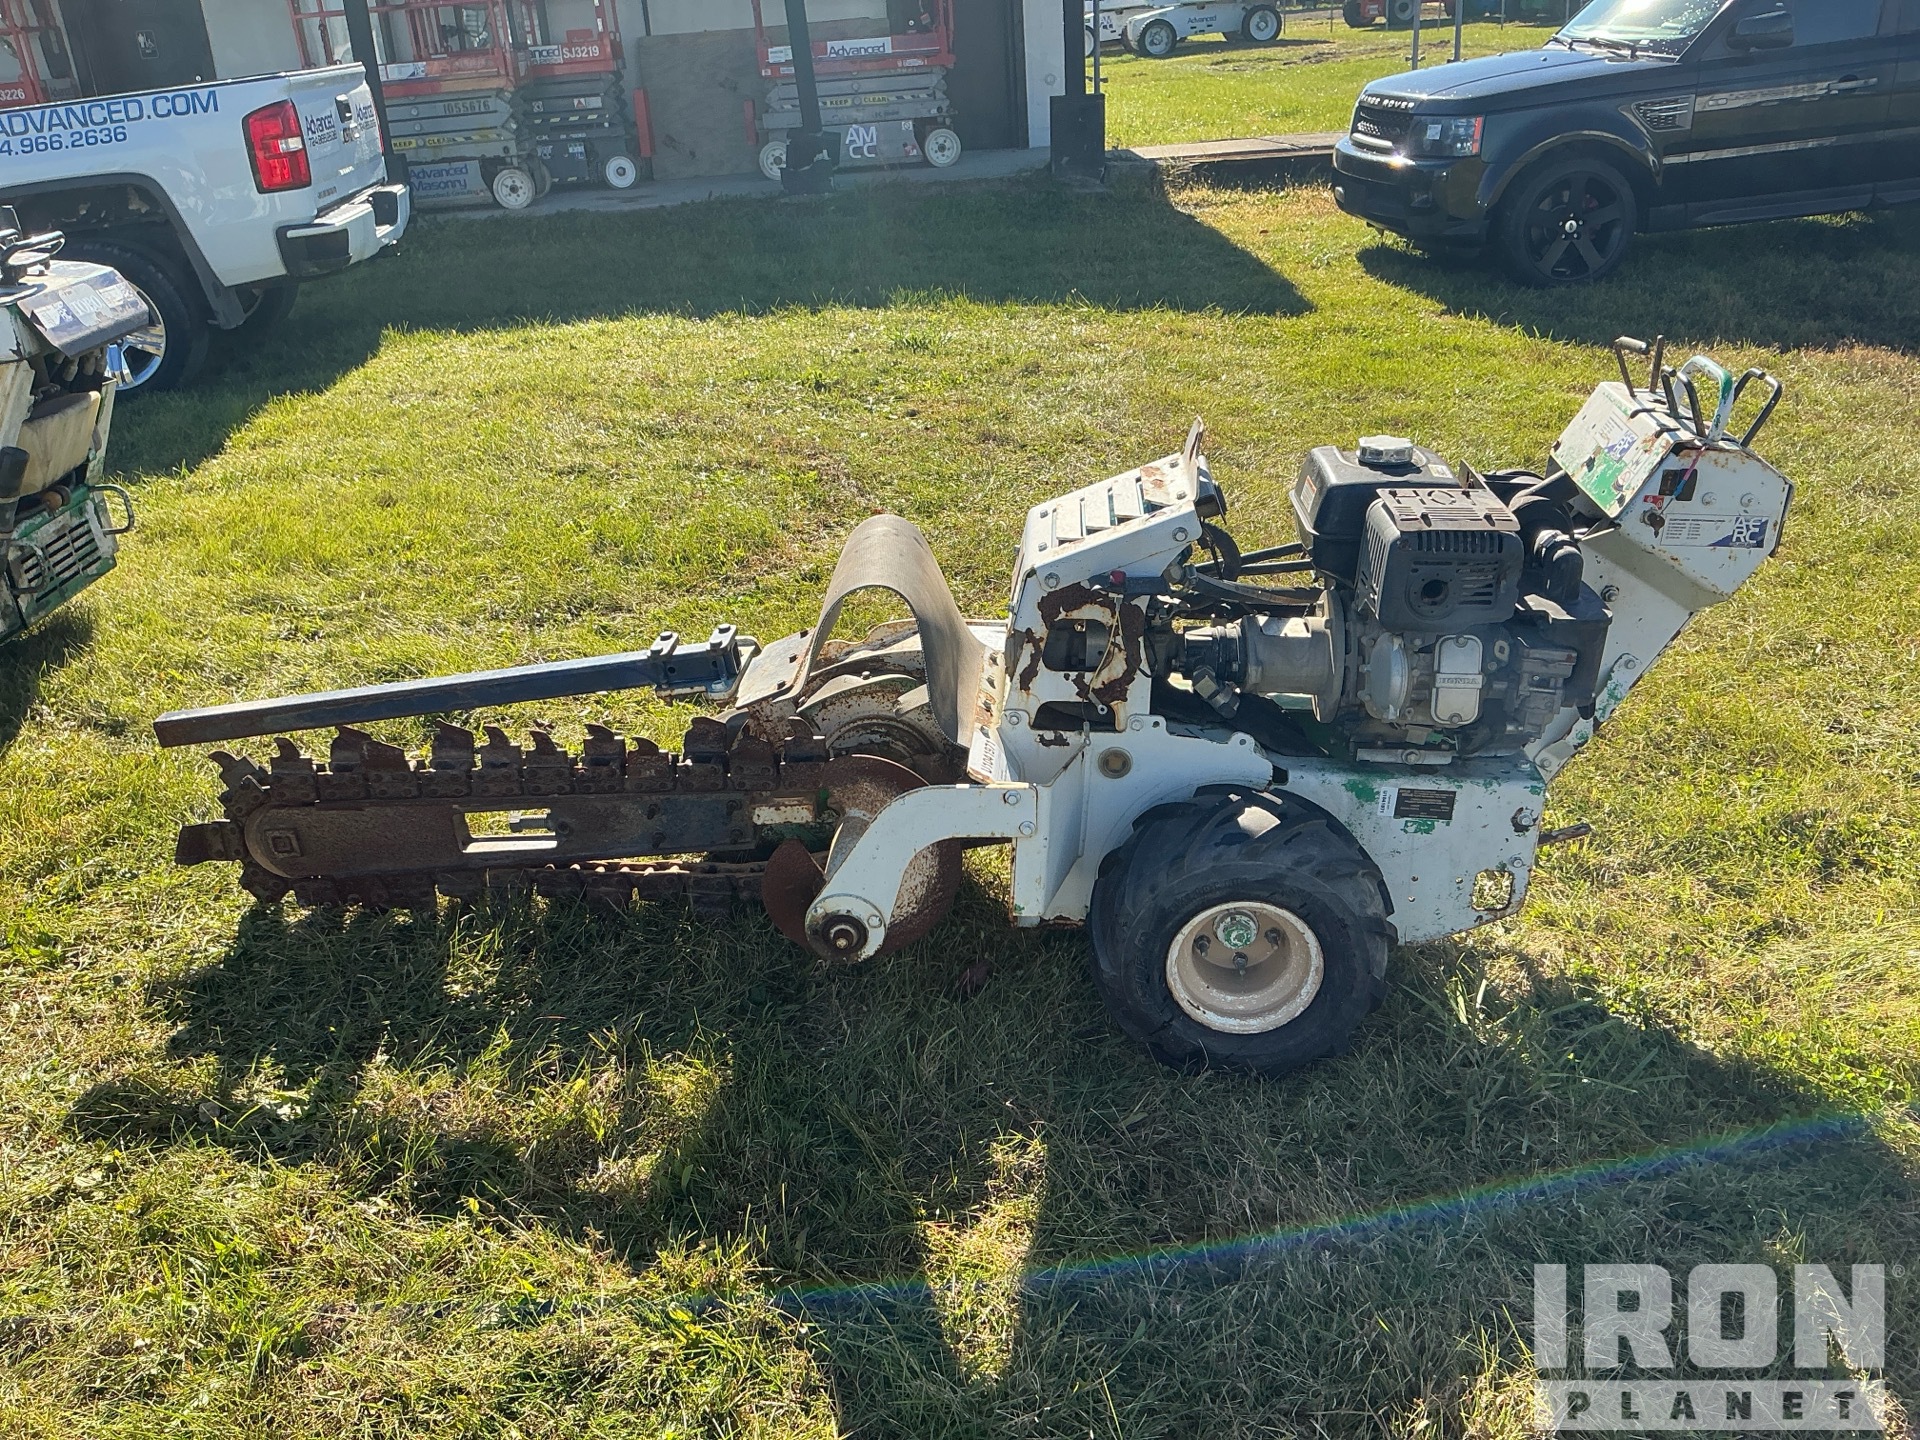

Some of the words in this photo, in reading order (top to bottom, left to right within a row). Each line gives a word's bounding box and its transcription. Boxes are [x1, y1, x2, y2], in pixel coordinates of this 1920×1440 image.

[1187, 15, 1217, 24] Advanced
[562, 45, 600, 59] SJ3219
[828, 43, 886, 58] Advanced
[0, 88, 26, 101] 3226
[443, 100, 491, 115] 1055676
[1383, 98, 1415, 110] ROVER
[305, 110, 336, 136] Advanced
[845, 124, 877, 146] AM
[393, 140, 413, 148] KEEP
[849, 142, 876, 159] CC
[410, 163, 469, 180] Advanced
[410, 179, 468, 192] Masonry
[1438, 677, 1480, 685] HONDA
